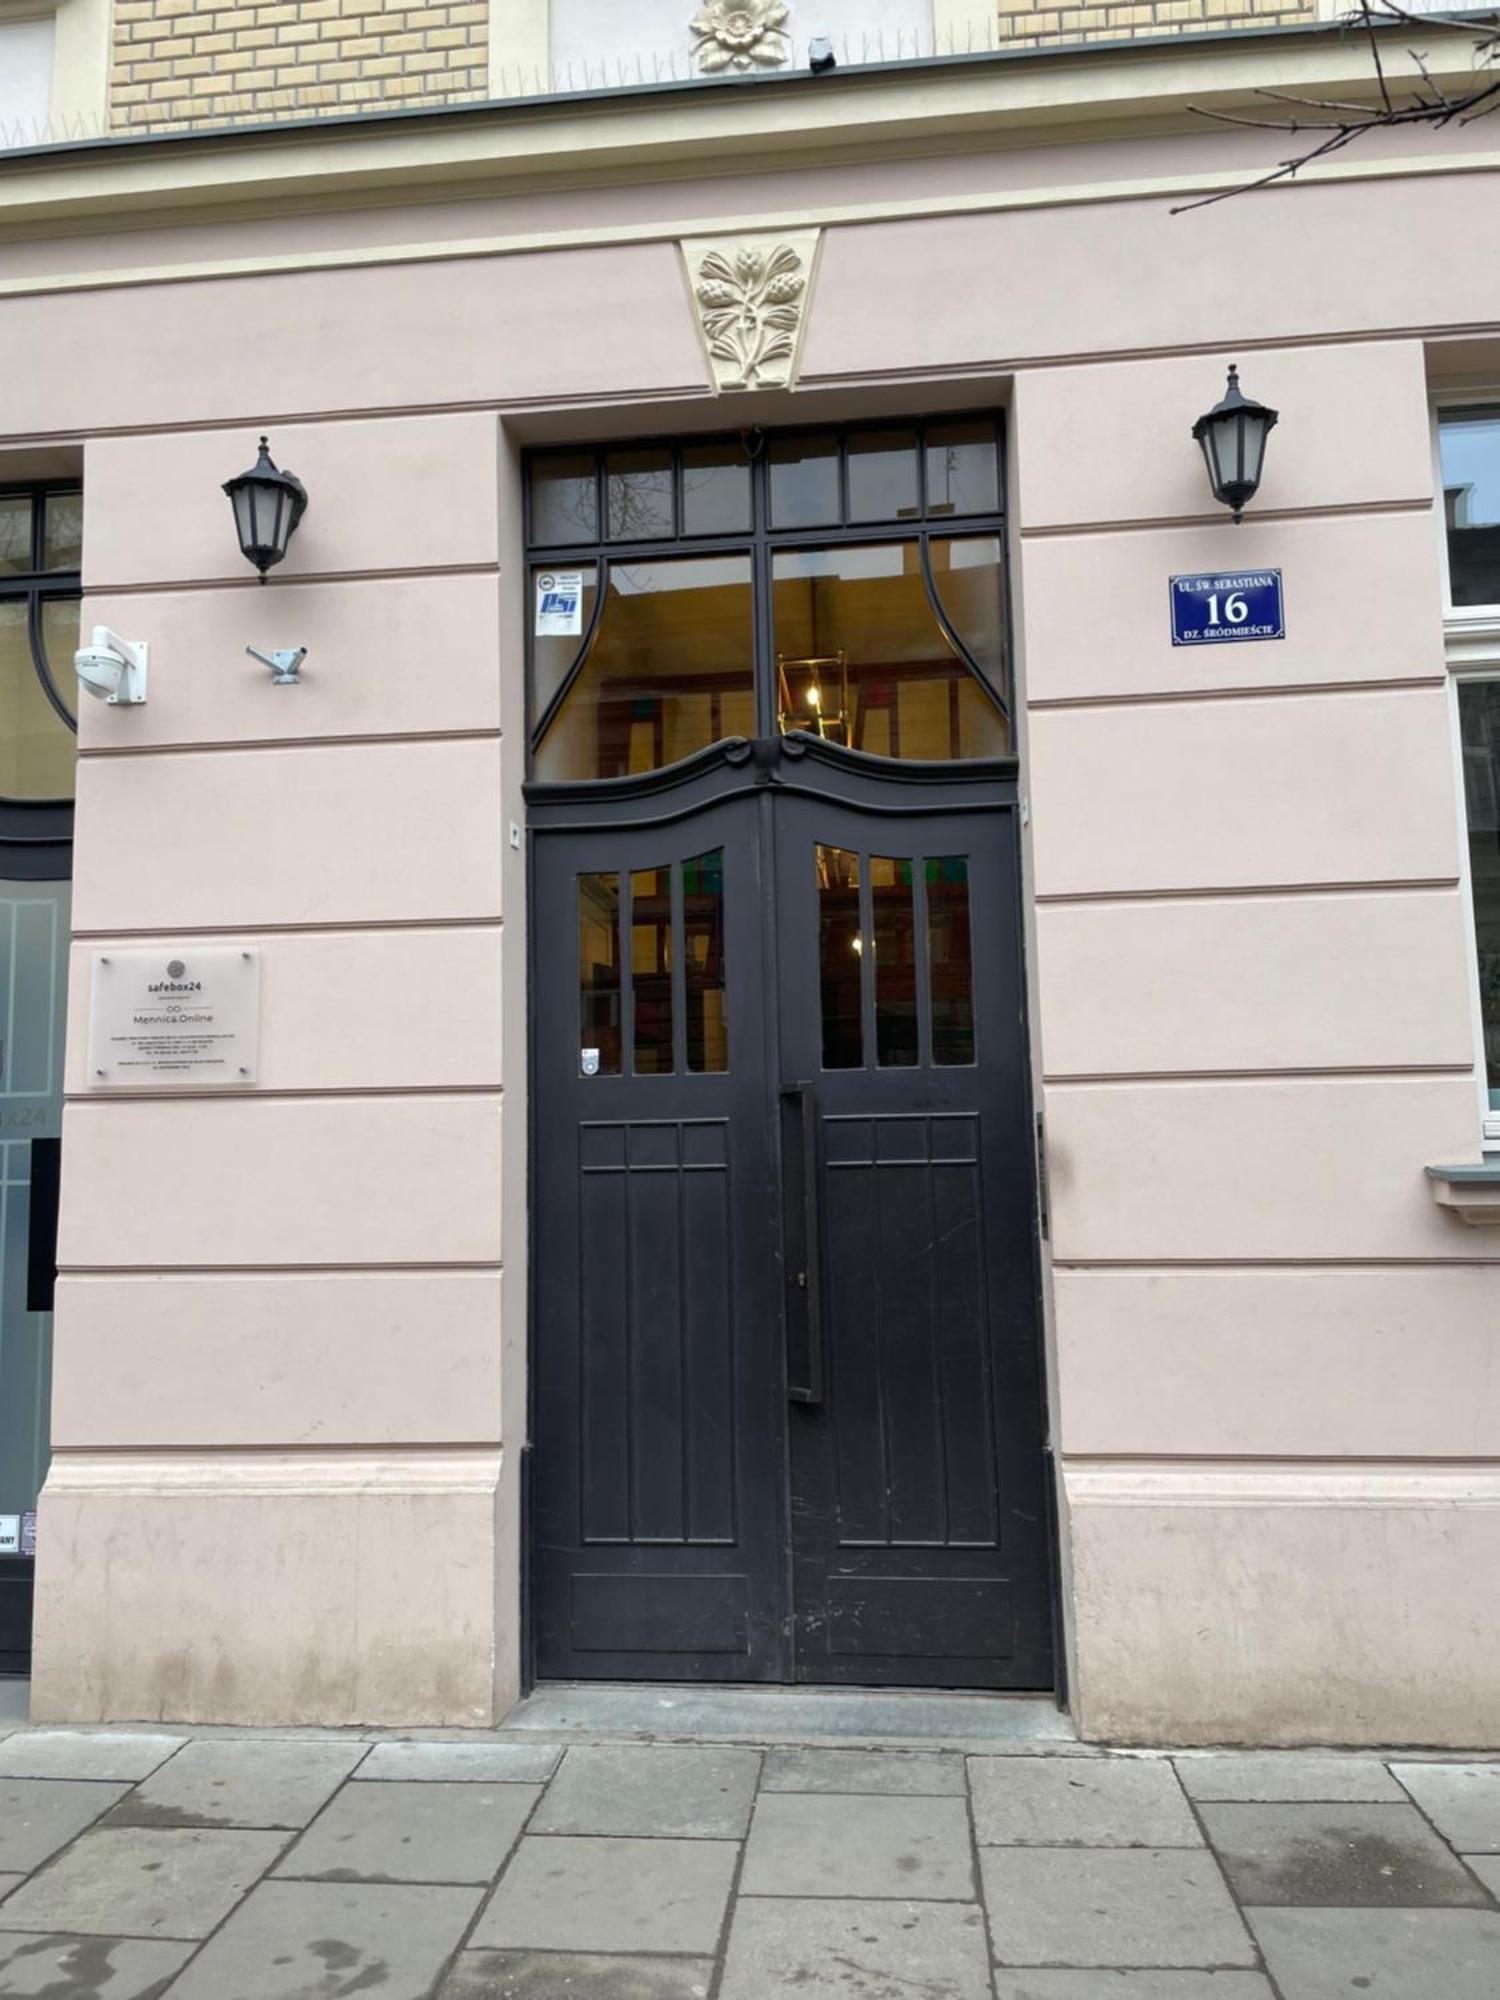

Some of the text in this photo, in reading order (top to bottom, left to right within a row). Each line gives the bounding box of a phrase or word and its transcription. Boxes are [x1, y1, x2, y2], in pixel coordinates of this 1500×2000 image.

[1178, 576, 1273, 593] UL. ŚW. SEBASTIANA
[1207, 592, 1248, 625] 16
[1183, 624, 1274, 640] DZ. ŚRÓDMIEŚCIE
[148, 981, 201, 993] safebox24
